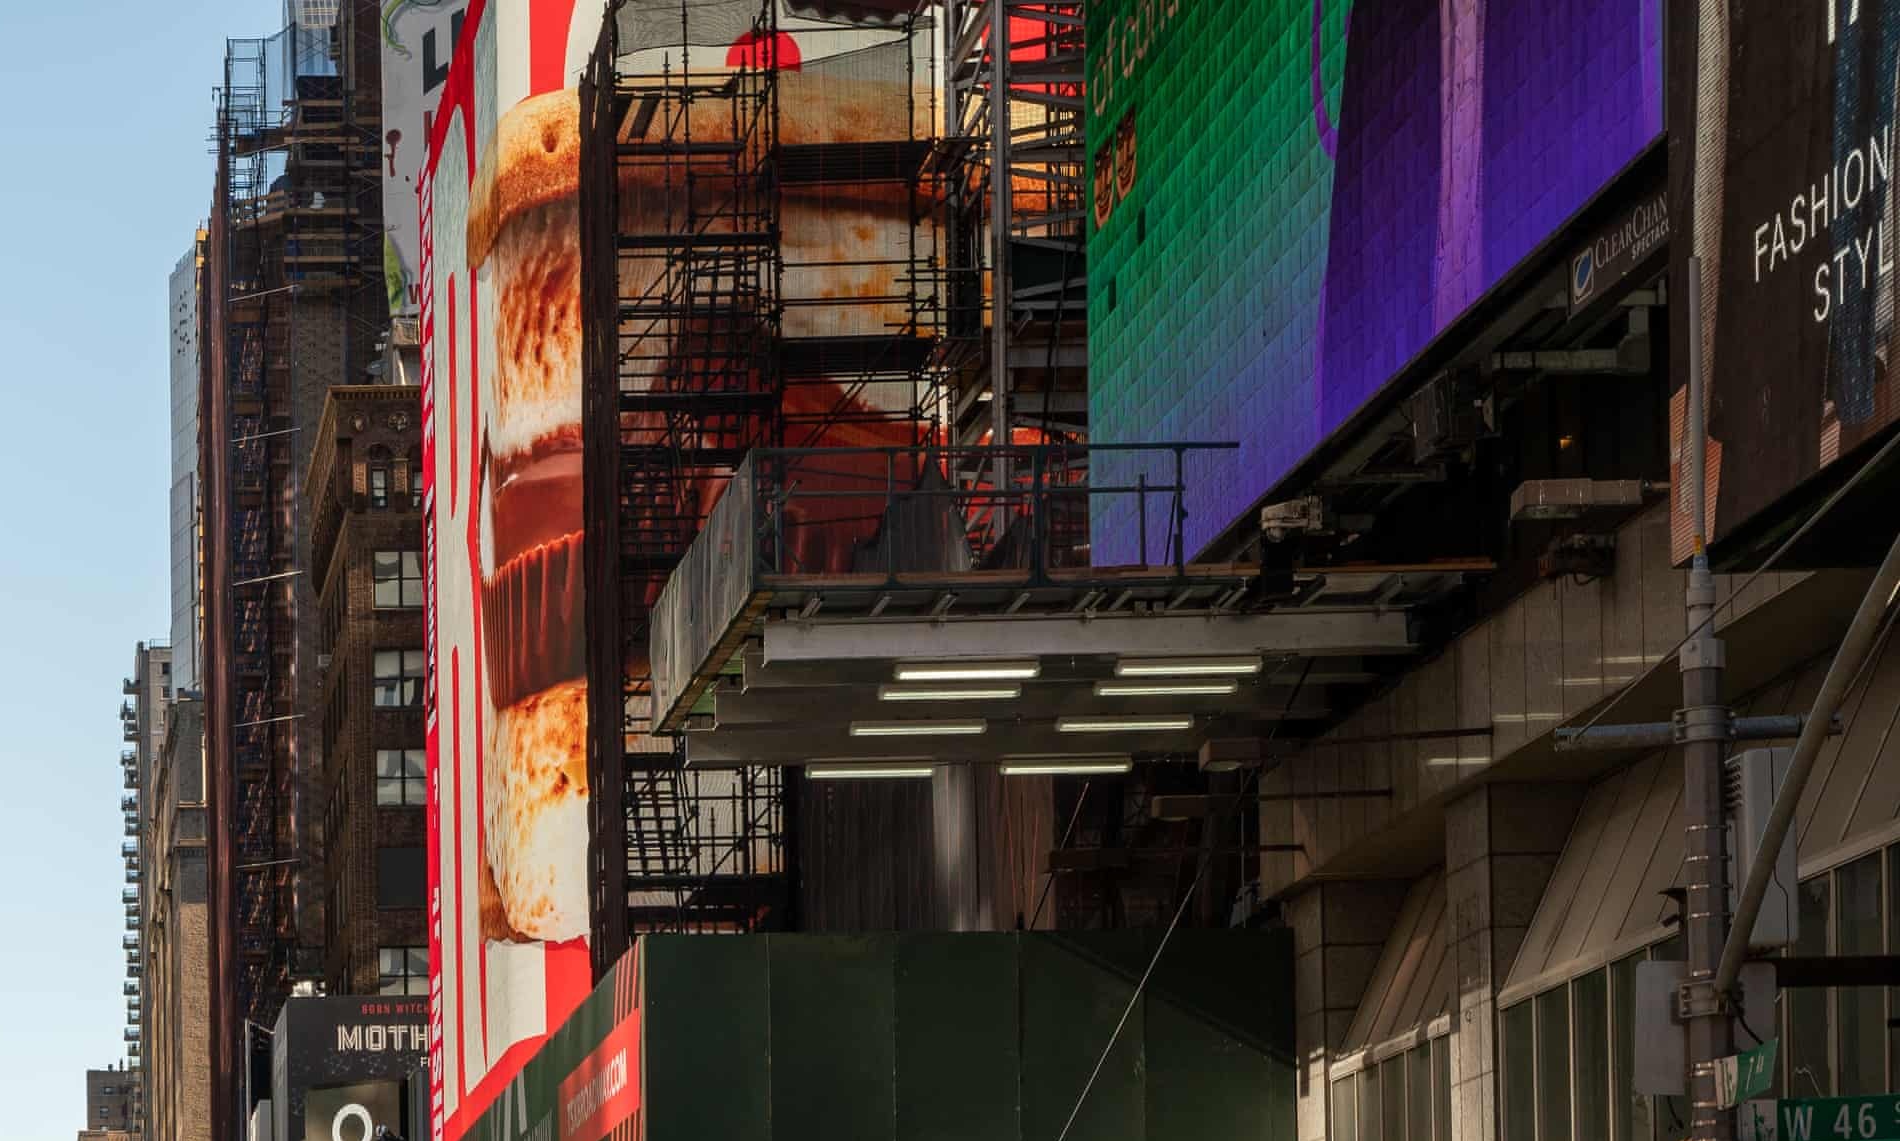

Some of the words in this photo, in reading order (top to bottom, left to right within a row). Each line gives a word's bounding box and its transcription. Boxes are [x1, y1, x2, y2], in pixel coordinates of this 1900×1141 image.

[1754, 126, 1890, 284] FASHION
[337, 1024, 429, 1052] MOTH
[1784, 1103, 1813, 1141] W
[1833, 1102, 1877, 1140] 46
